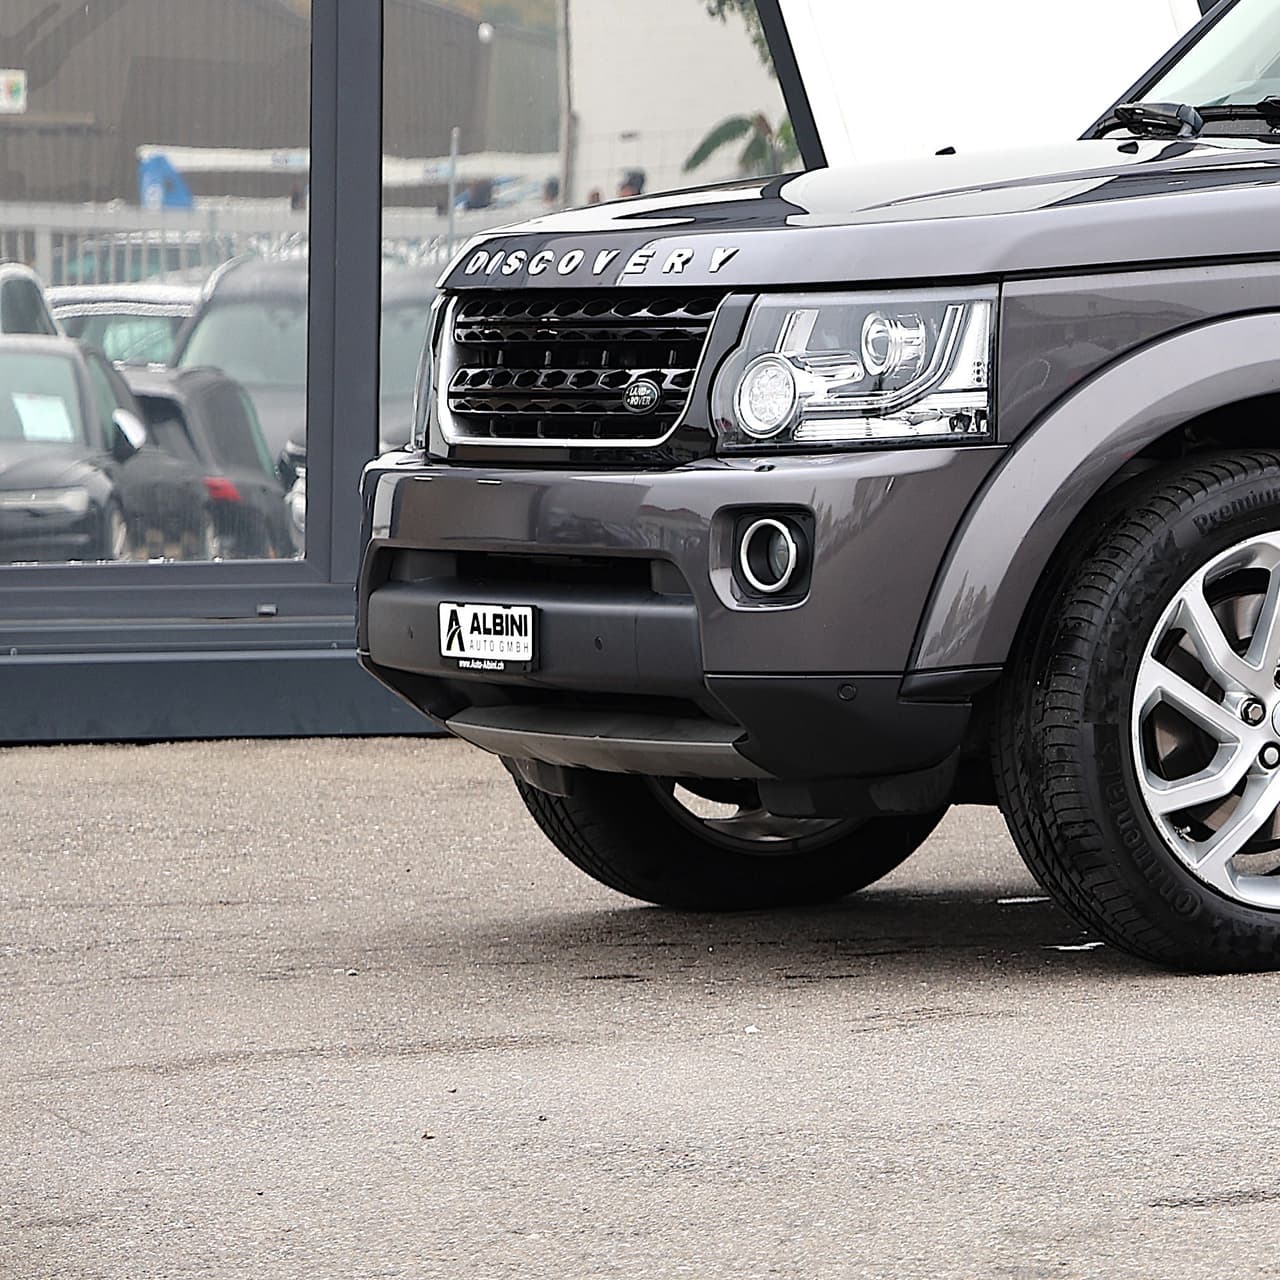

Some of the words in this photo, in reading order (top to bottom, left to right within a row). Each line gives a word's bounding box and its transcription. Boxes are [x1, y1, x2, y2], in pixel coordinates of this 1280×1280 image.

[464, 247, 740, 275] DISCOVERY
[469, 612, 529, 637] ALBINI
[469, 639, 495, 652] AUTO
[499, 640, 529, 653] GMBH
